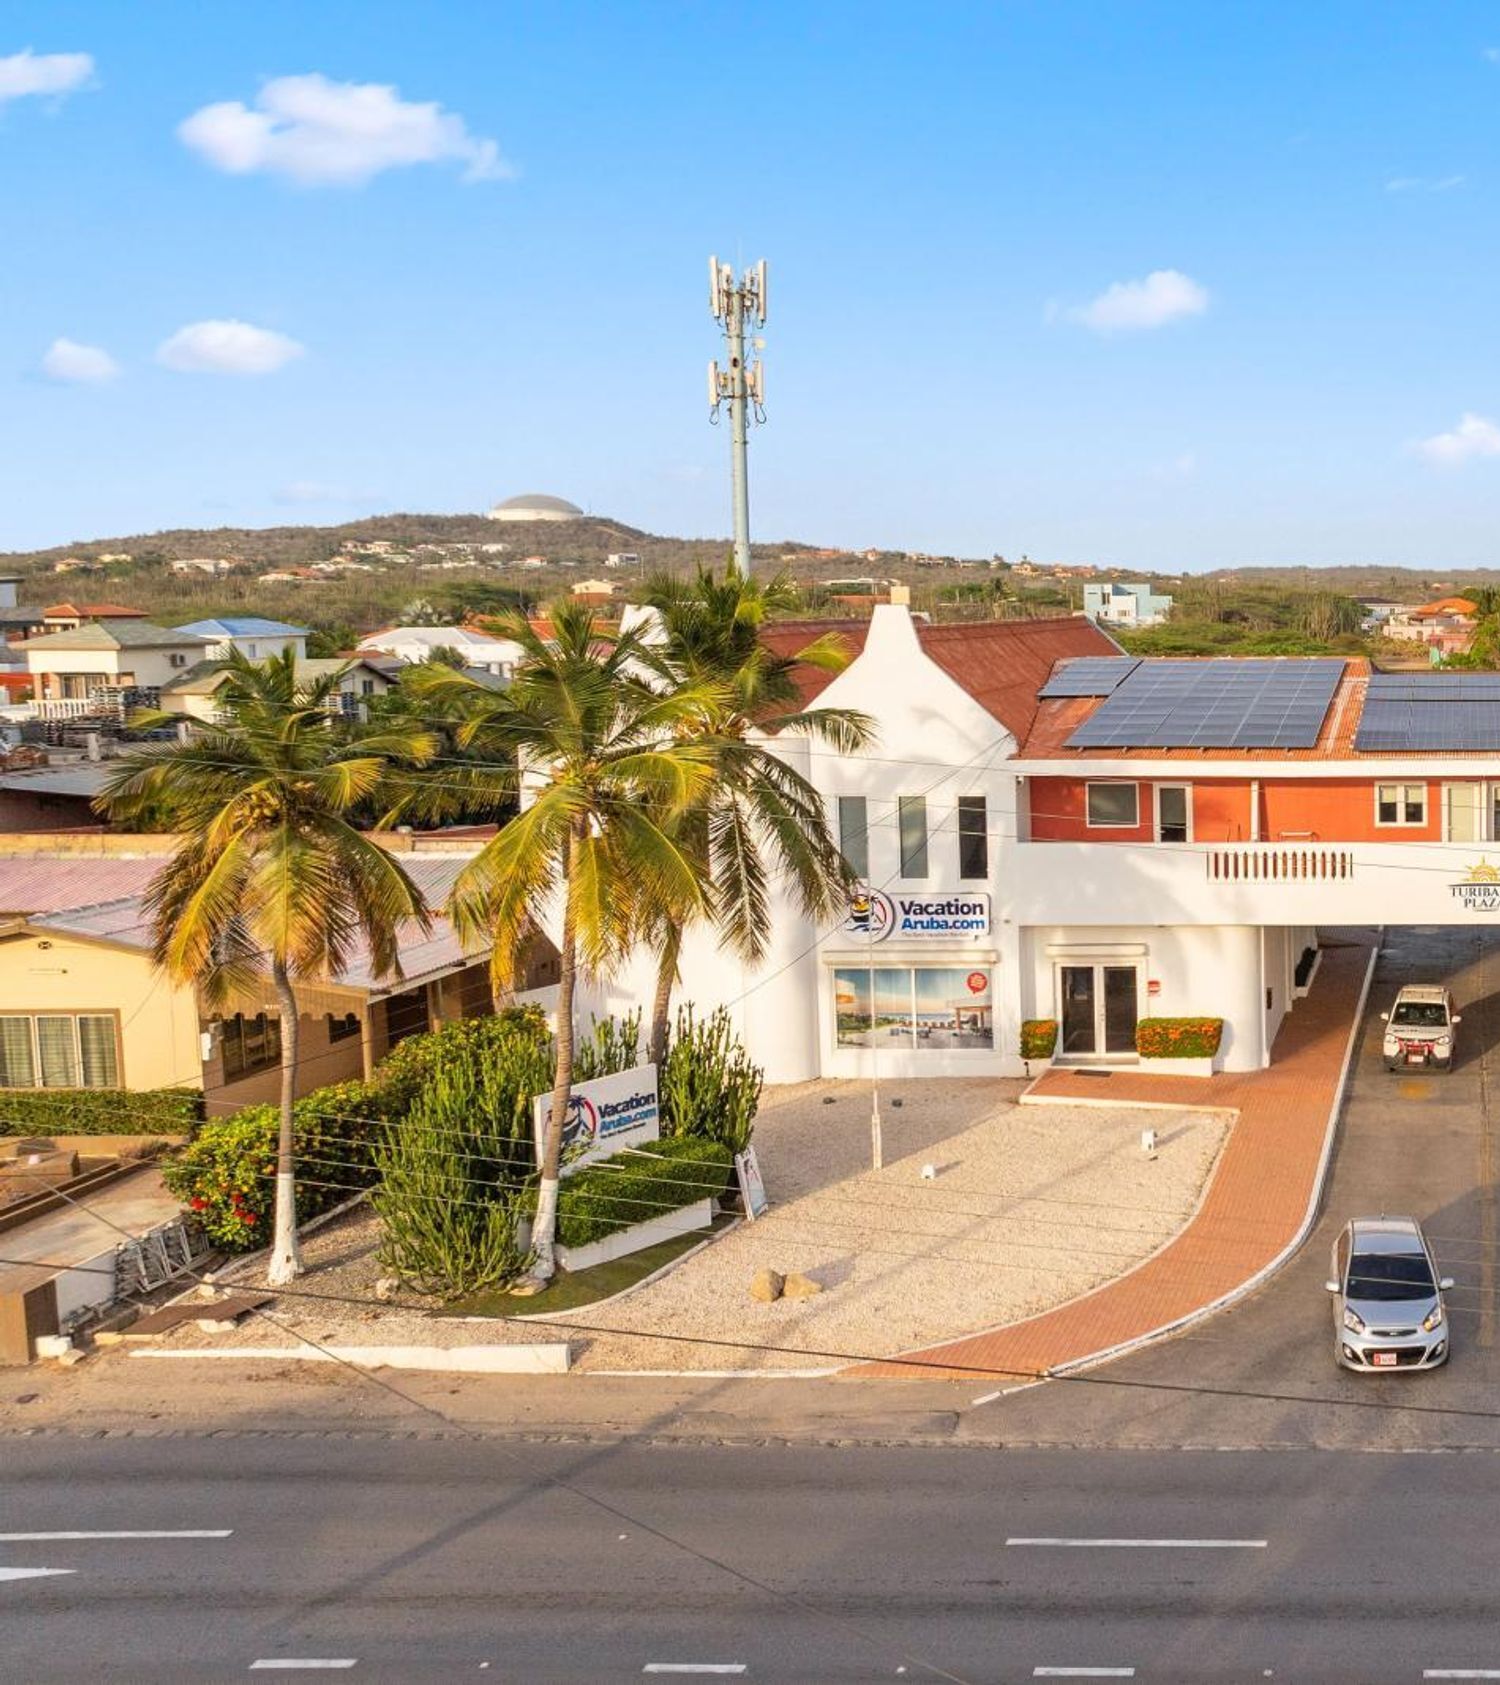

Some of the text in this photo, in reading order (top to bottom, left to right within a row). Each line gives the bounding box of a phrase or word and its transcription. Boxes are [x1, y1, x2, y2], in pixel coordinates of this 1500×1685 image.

[899, 898, 984, 915] Vacation
[901, 917, 985, 930] Aruba.com
[597, 1092, 656, 1119] Vacation
[600, 1107, 657, 1132] Aruba.com
